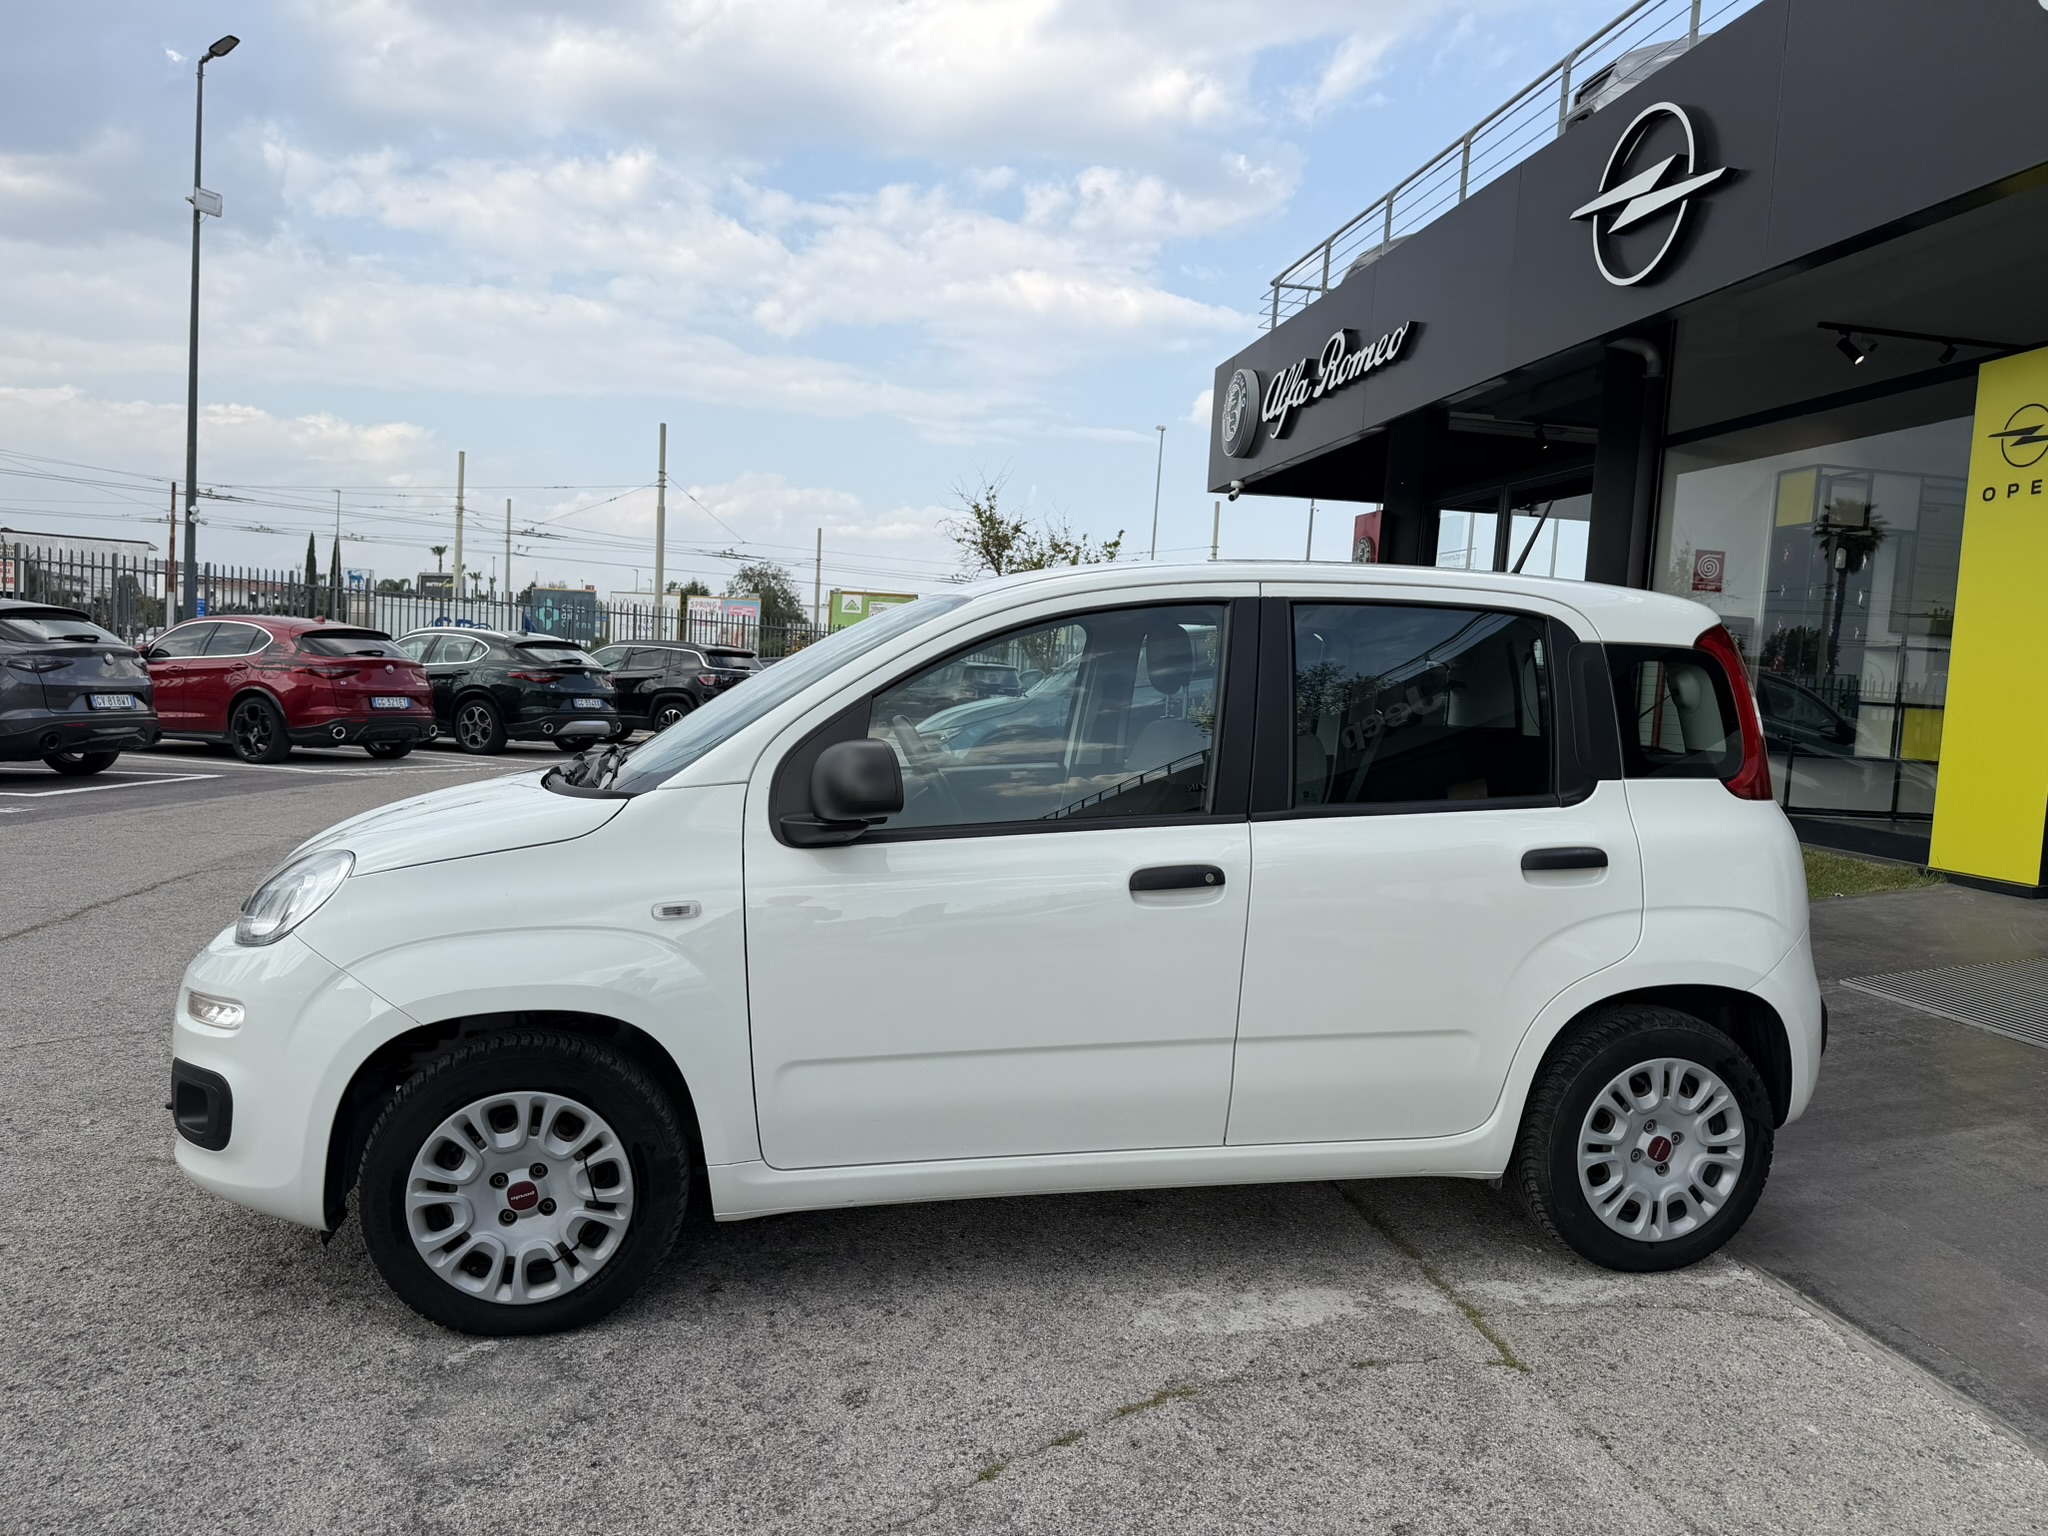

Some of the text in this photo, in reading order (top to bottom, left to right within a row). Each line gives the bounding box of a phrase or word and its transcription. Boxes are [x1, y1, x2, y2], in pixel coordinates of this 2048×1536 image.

[1262, 358, 1312, 439] Alfa
[1313, 321, 1410, 398] Romeo
[1982, 479, 2043, 502] OPE
[690, 601, 717, 609] SPRING
